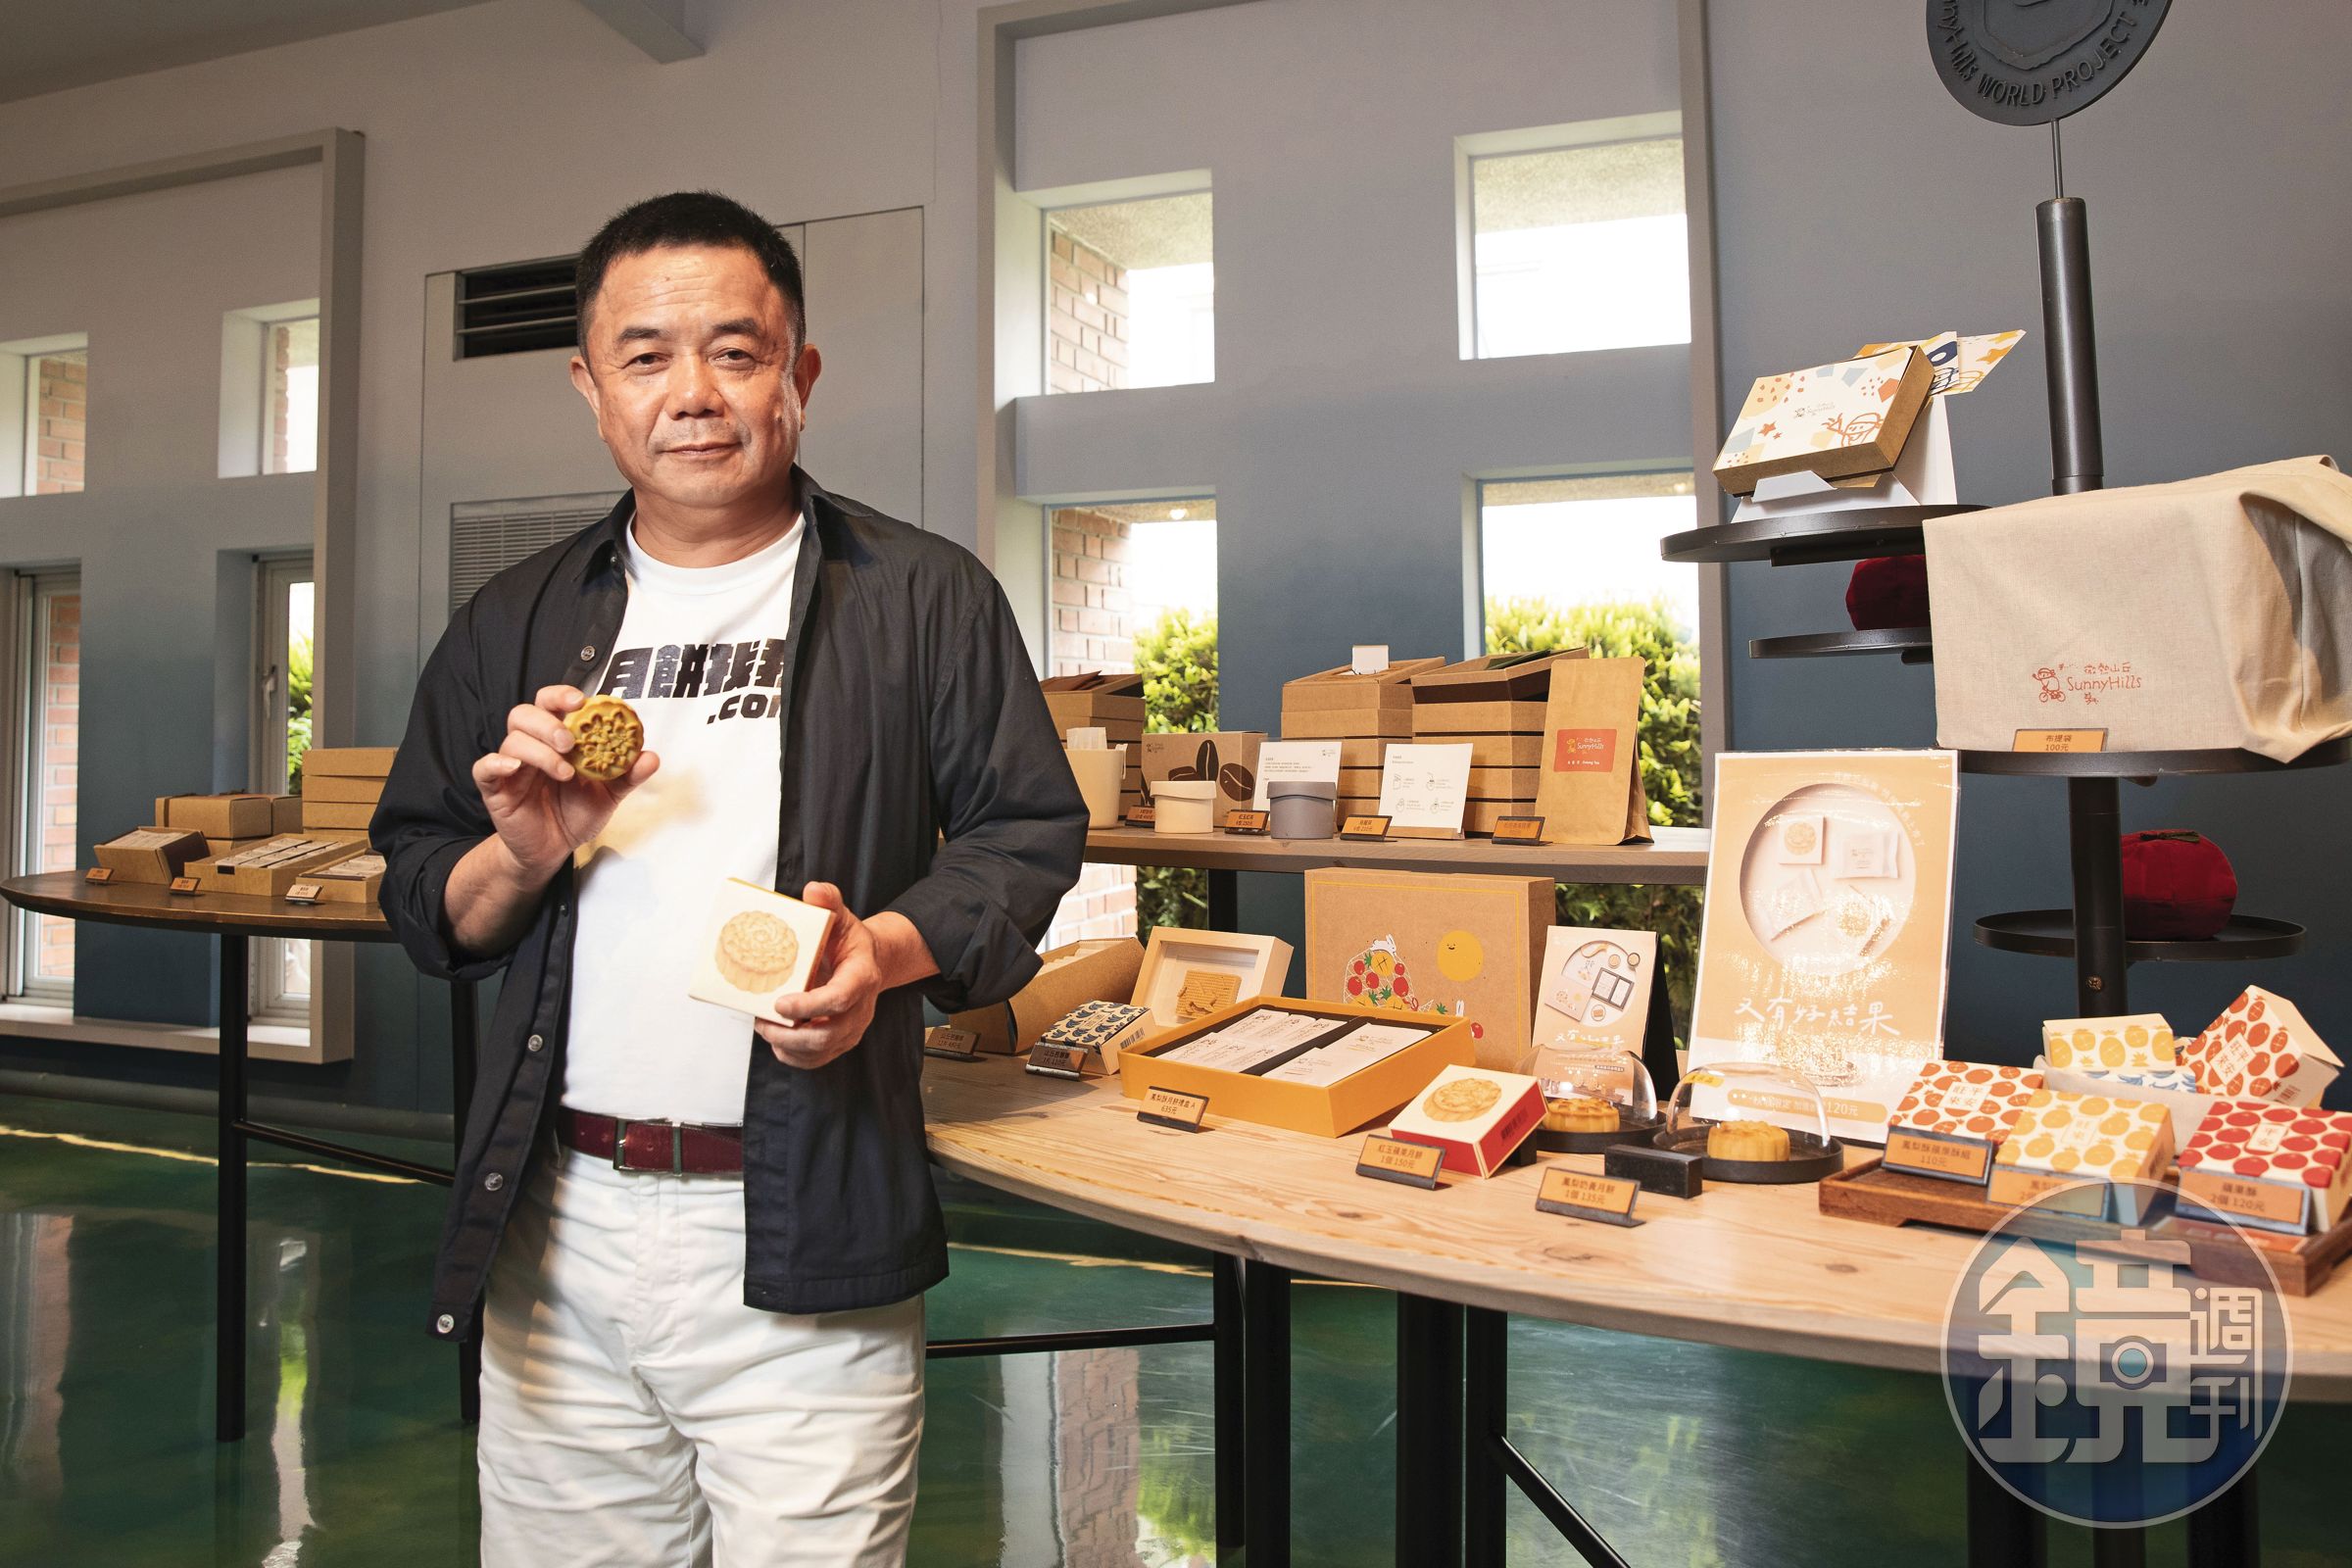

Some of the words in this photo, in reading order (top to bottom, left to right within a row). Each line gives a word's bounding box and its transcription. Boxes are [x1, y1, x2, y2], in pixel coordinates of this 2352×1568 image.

[1977, 74, 2046, 107] WORLD
[2050, 12, 2137, 99] PROJECT
[2067, 675, 2142, 692] SunnyHills
[2045, 734, 2072, 743] 布提袋
[1734, 995, 1901, 1036] 又有好結果
[1160, 1104, 1178, 1115] 635元
[1827, 1100, 1859, 1117] 120元
[1395, 1156, 1416, 1169] 150元
[1920, 1154, 1946, 1167] 110元
[2232, 1199, 2266, 1212] 120元
